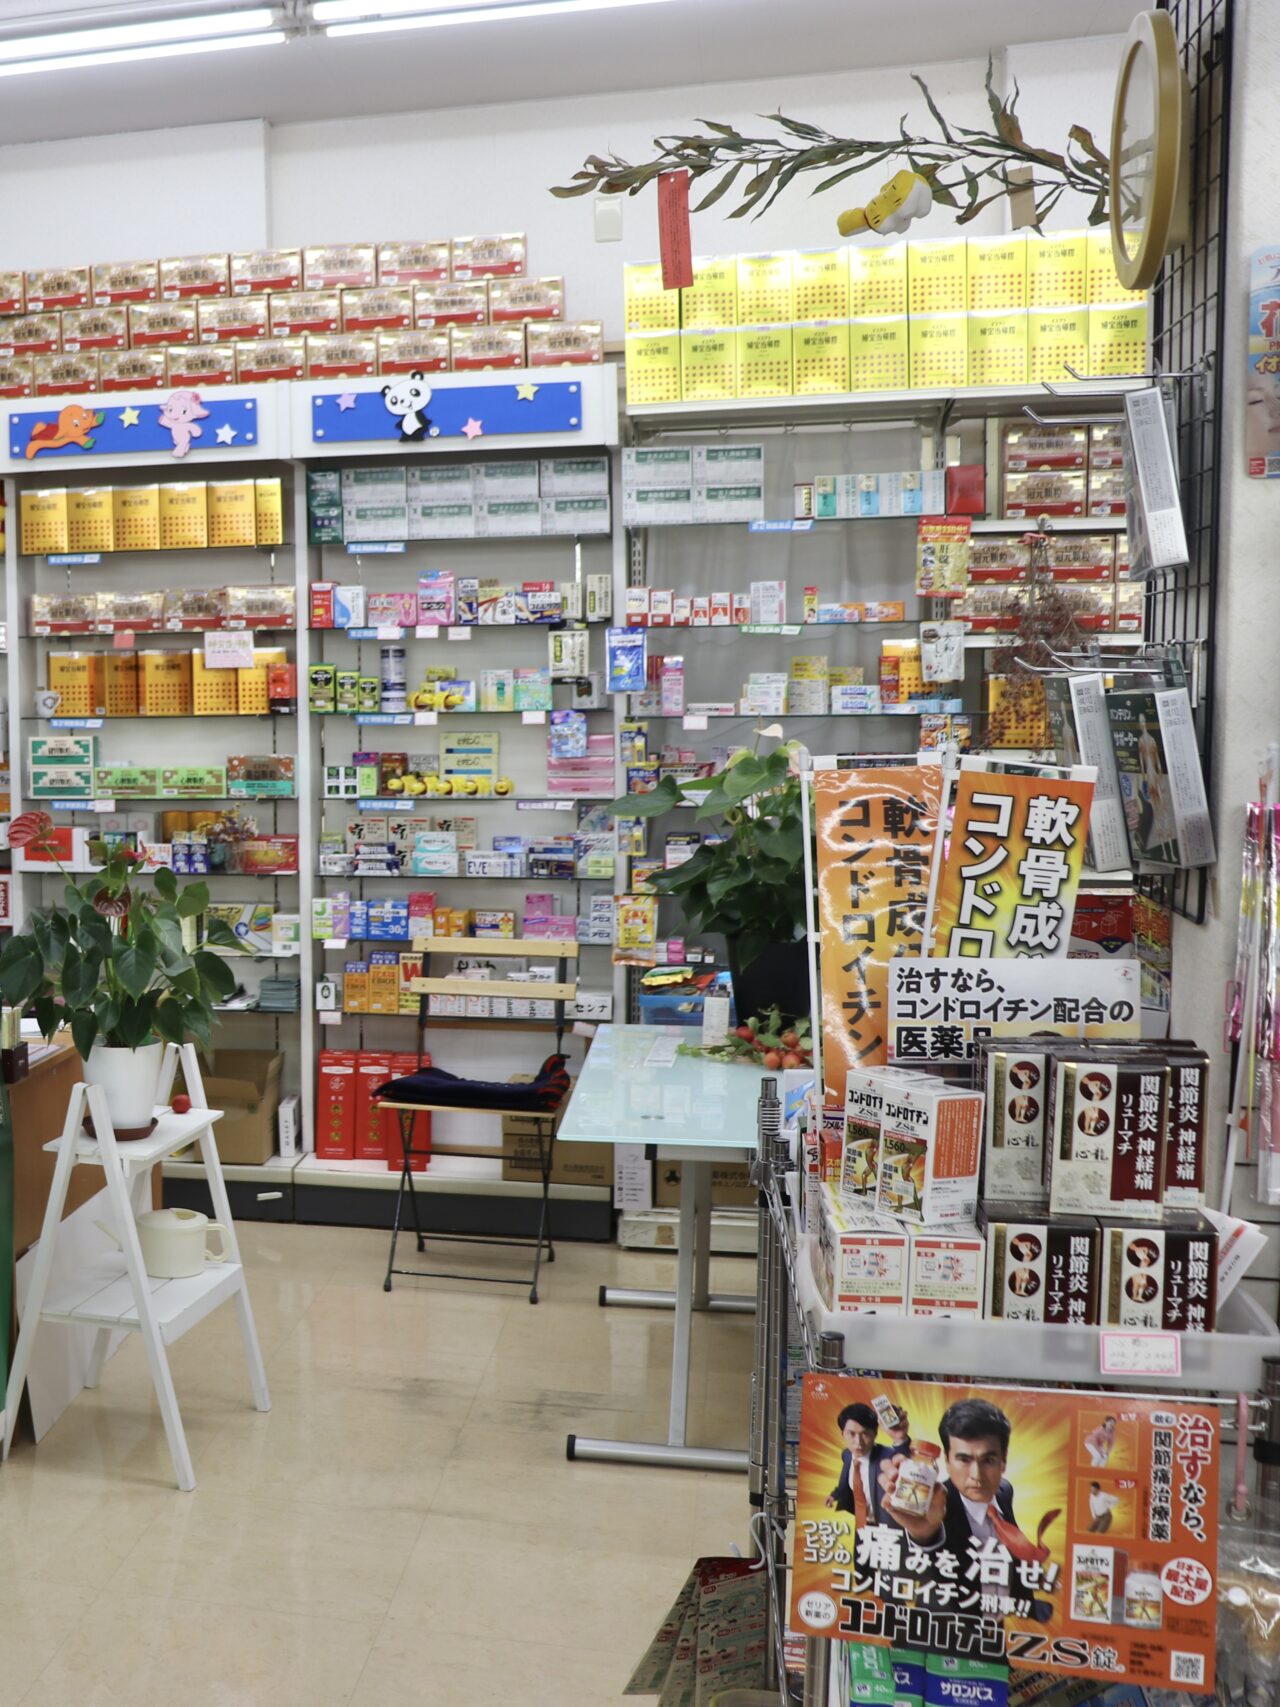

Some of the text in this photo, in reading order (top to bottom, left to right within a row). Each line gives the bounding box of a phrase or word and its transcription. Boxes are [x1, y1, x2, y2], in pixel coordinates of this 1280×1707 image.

[467, 861, 487, 875] EVE
[1007, 793, 1081, 958] 軟骨成
[839, 798, 883, 1063] コンドロイチン
[896, 966, 1008, 994] 治すなら、
[574, 1003, 609, 1013] センナ
[896, 996, 1135, 1025] コンドロイチン配合の
[848, 1089, 883, 1110] コンドロイチ
[885, 1102, 929, 1125] コンドロイチン
[1117, 1093, 1135, 1156] リューマチ
[1134, 1074, 1161, 1191] 関節炎 神経痛
[1176, 1067, 1201, 1181] 関節炎 神経痛
[1047, 1254, 1065, 1317] リューマチ
[1068, 1235, 1091, 1294] 関節炎
[1187, 1240, 1210, 1300] 関節炎
[1166, 1259, 1184, 1323] リューマチ
[1149, 1429, 1174, 1544] 関節痛治療薬
[1176, 1412, 1215, 1543] 治すなら、
[801, 1519, 851, 1536] つらい
[803, 1547, 852, 1565] コシの
[1175, 1560, 1205, 1575] 日本で
[1170, 1586, 1198, 1602] 配合
[939, 1680, 994, 1701] サロンパス
